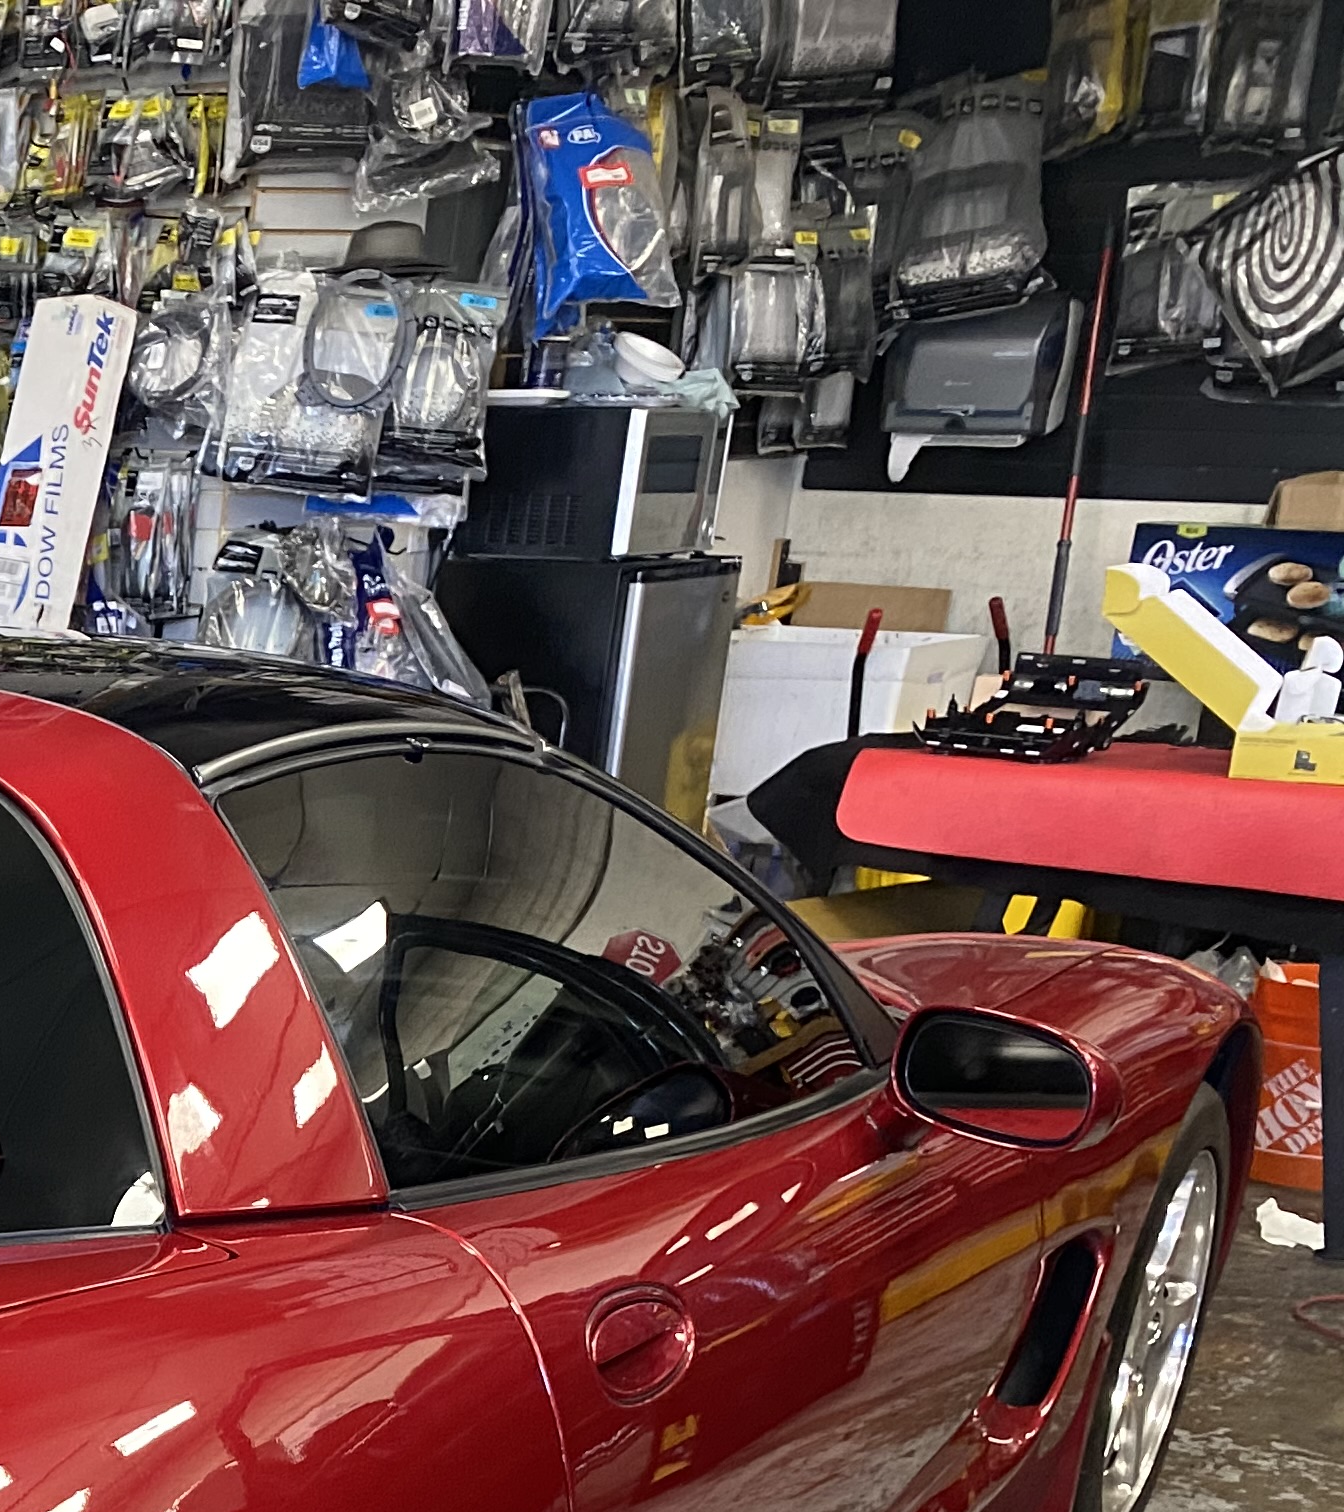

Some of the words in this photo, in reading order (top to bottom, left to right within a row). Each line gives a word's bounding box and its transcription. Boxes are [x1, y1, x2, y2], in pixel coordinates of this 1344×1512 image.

[73, 308, 115, 435] SunTek
[45, 424, 70, 515] FILMS
[35, 526, 56, 602] DOW
[1142, 540, 1235, 575] Oster
[1255, 1073, 1322, 1149] HOM
[1263, 1059, 1314, 1099] THE
